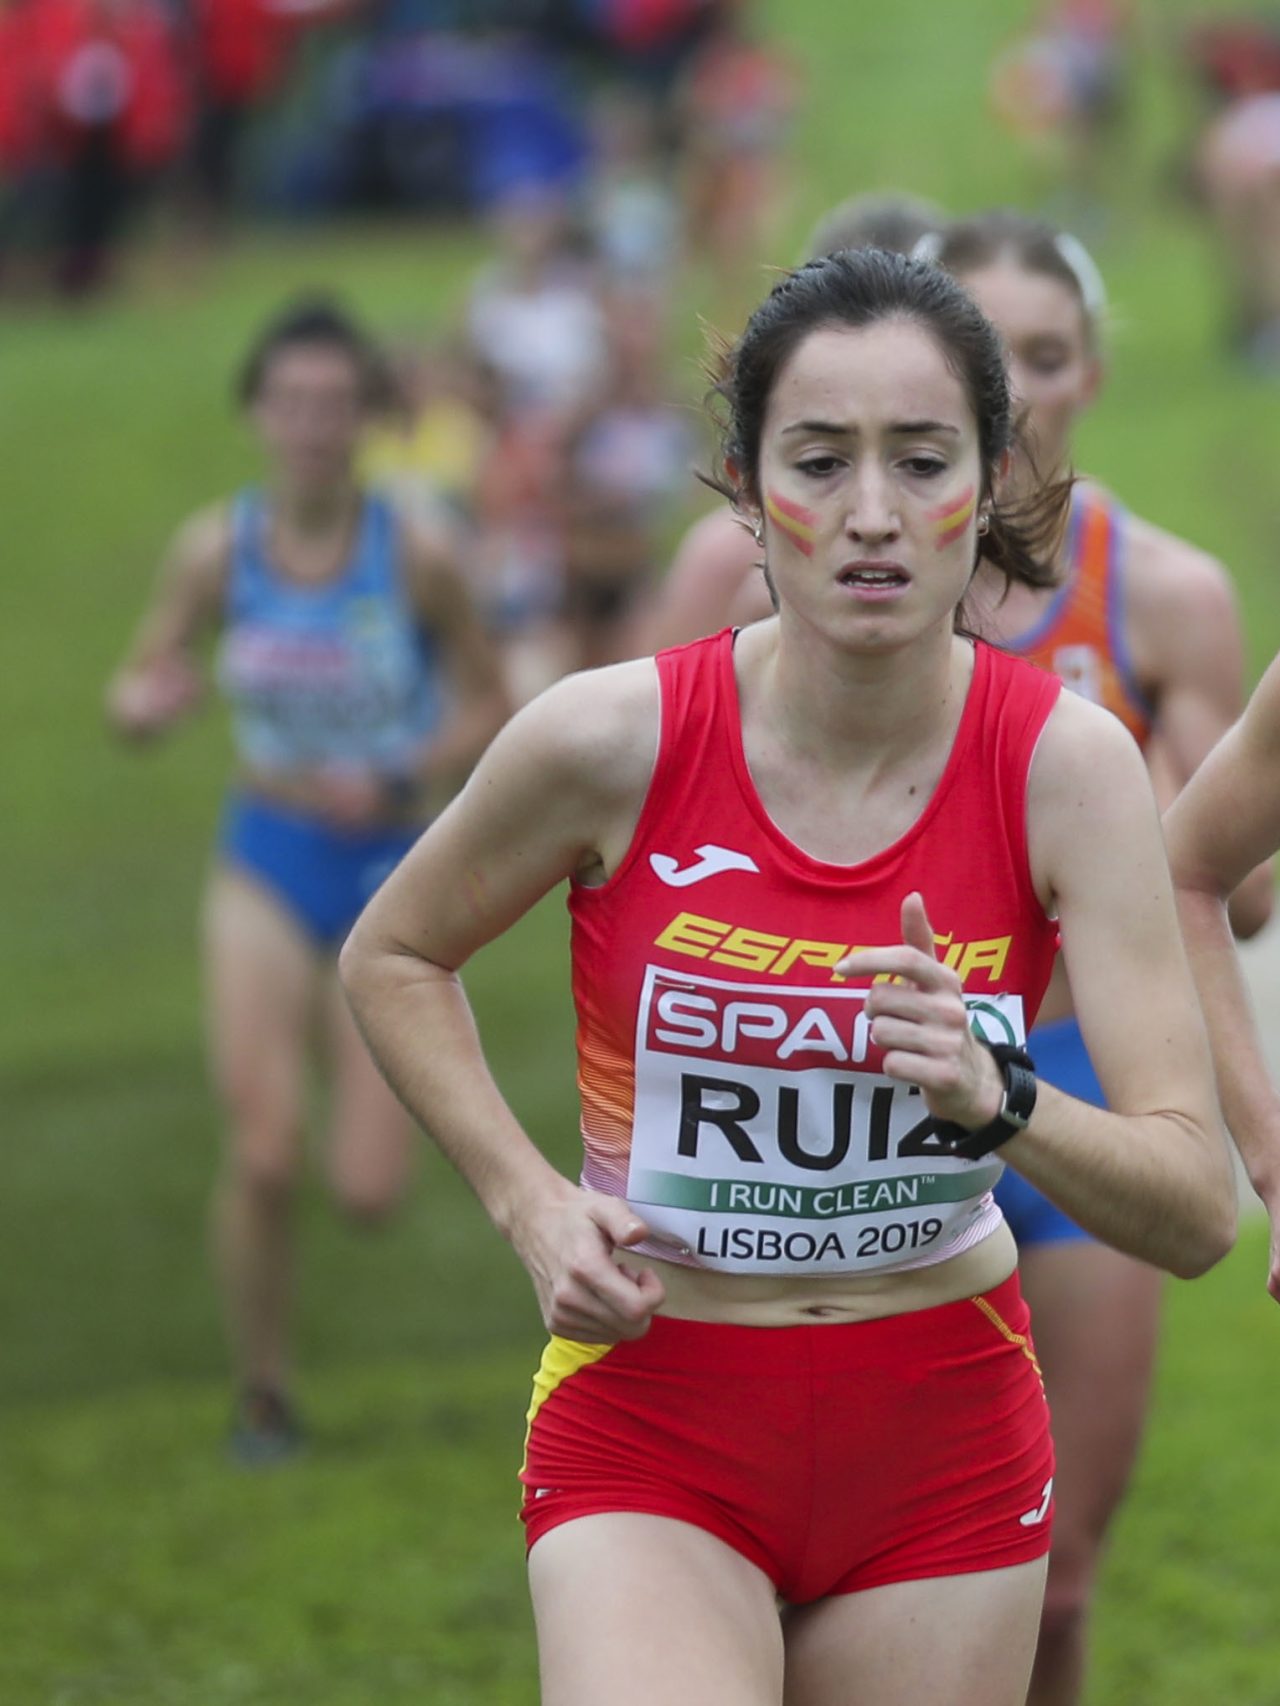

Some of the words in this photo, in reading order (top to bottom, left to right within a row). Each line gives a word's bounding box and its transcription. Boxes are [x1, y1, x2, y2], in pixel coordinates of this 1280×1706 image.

[709, 1185, 719, 1207] I
[728, 1184, 802, 1213] RUN
[697, 1226, 847, 1262] LISBOA
[856, 1217, 943, 1259] 2019
